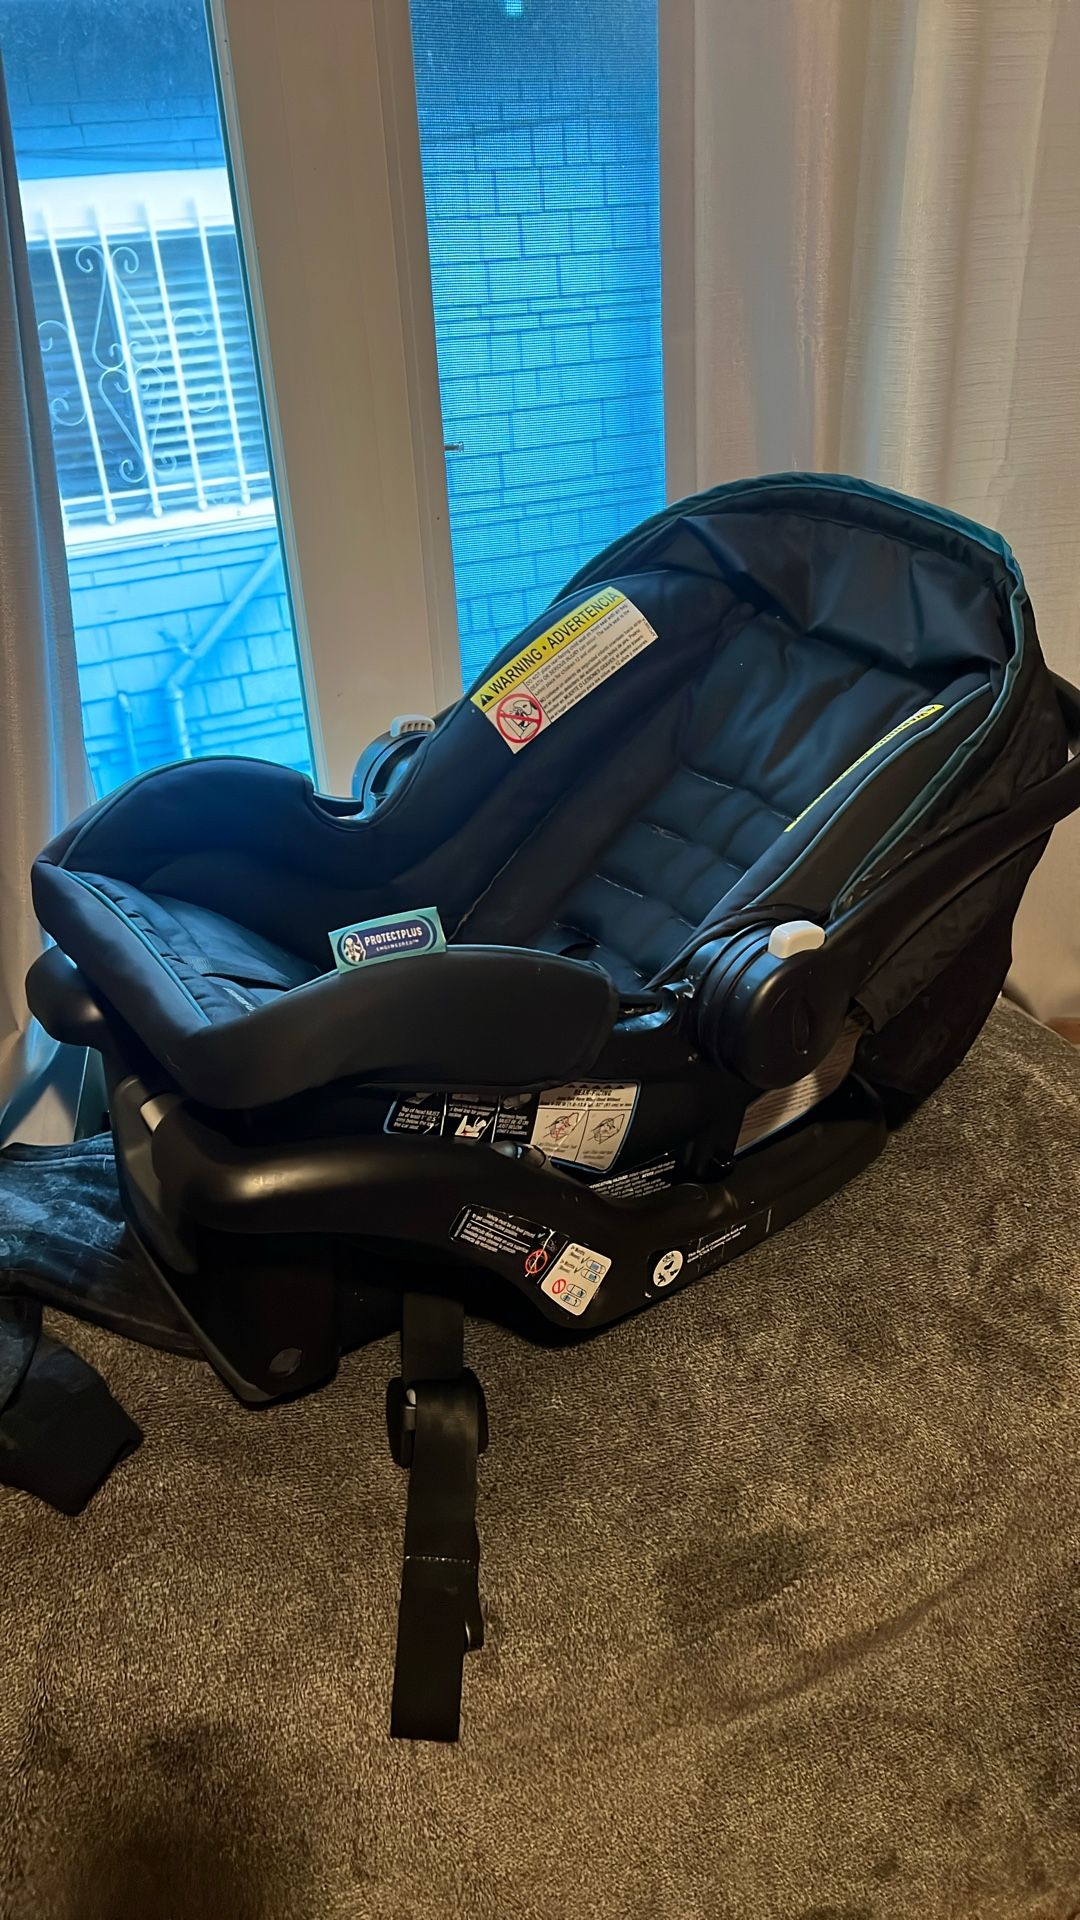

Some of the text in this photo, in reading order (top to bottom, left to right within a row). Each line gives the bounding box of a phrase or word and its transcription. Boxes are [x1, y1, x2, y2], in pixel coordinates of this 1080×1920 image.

[490, 591, 620, 694] WARNING ADVERTENCIA
[364, 927, 422, 946] PROTECTPLUS
